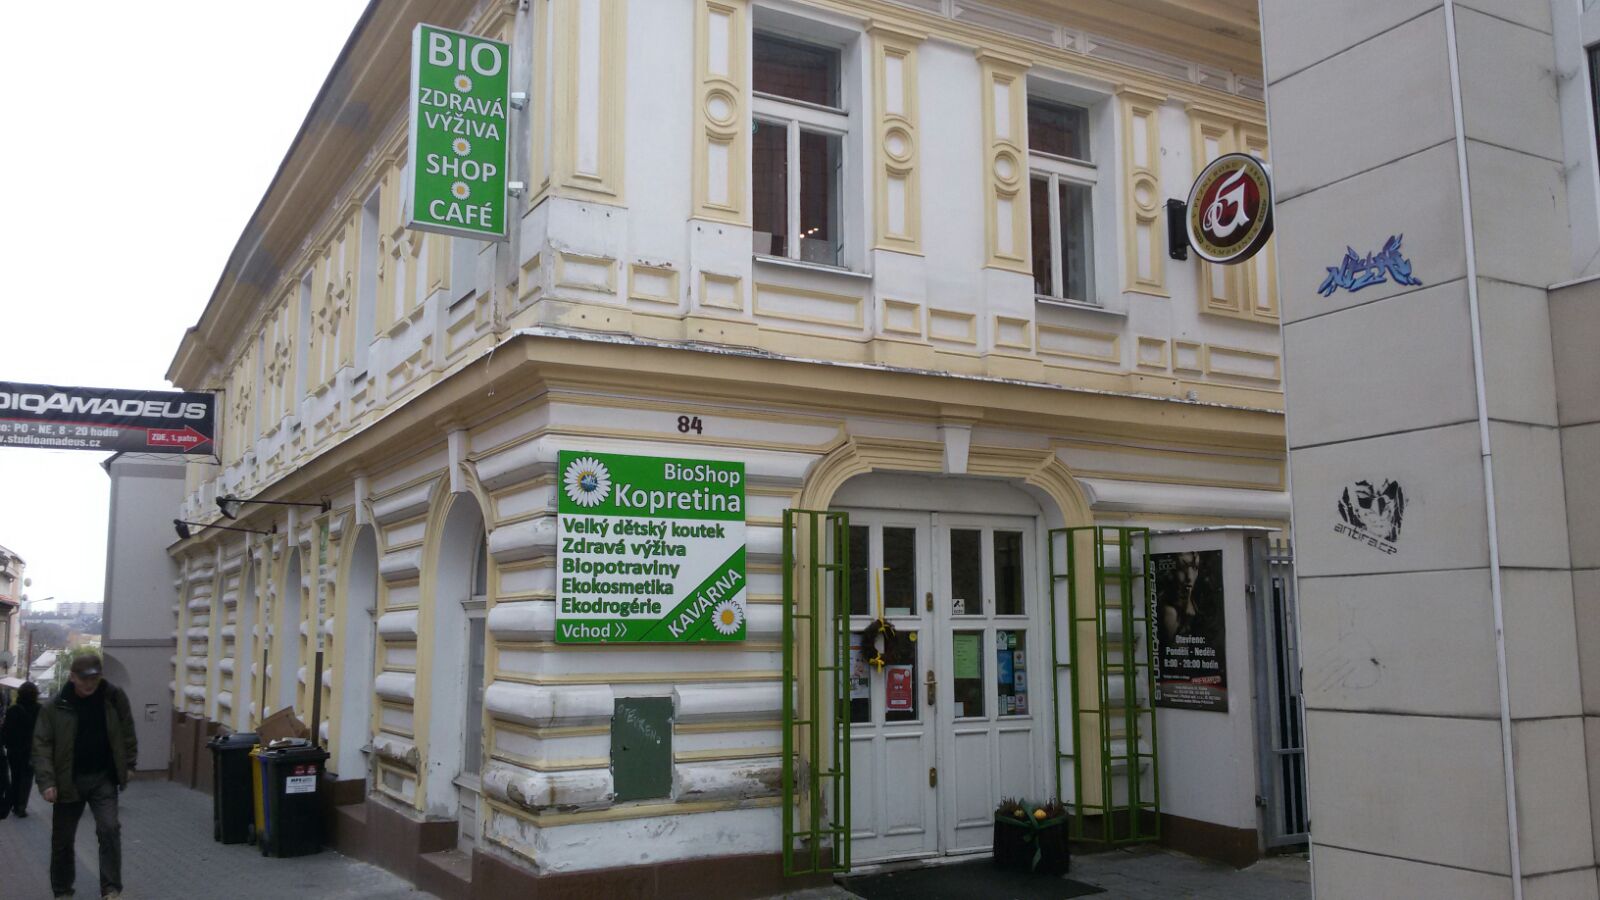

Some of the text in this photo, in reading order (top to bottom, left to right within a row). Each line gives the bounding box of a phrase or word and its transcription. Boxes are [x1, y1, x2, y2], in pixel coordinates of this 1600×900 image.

[428, 31, 503, 77] BIO
[420, 87, 505, 120] ZDRAVÁ
[424, 111, 500, 141] VÝŽIVA
[426, 153, 497, 183] SHOP
[429, 199, 493, 228] CAFÉ
[14, 423, 28, 433] PO
[38, 424, 56, 436] NE,
[58, 425, 66, 435] 8
[75, 427, 88, 436] 20
[90, 427, 119, 437] hodin
[677, 415, 703, 435] 84
[664, 463, 741, 488] BioShop
[615, 483, 741, 515] Kopretina
[562, 517, 725, 540] Velký dětský koutek
[562, 537, 687, 559] Zdravá výživa
[562, 557, 680, 579] Biopotraviny
[562, 578, 674, 595] Ekokosmetika
[561, 597, 662, 617] Ekodrogérie
[667, 568, 743, 639] KAVÁRNA
[561, 623, 611, 638] Vchod
[1194, 647, 1216, 657] Neděle
[1202, 660, 1219, 670] hodin
